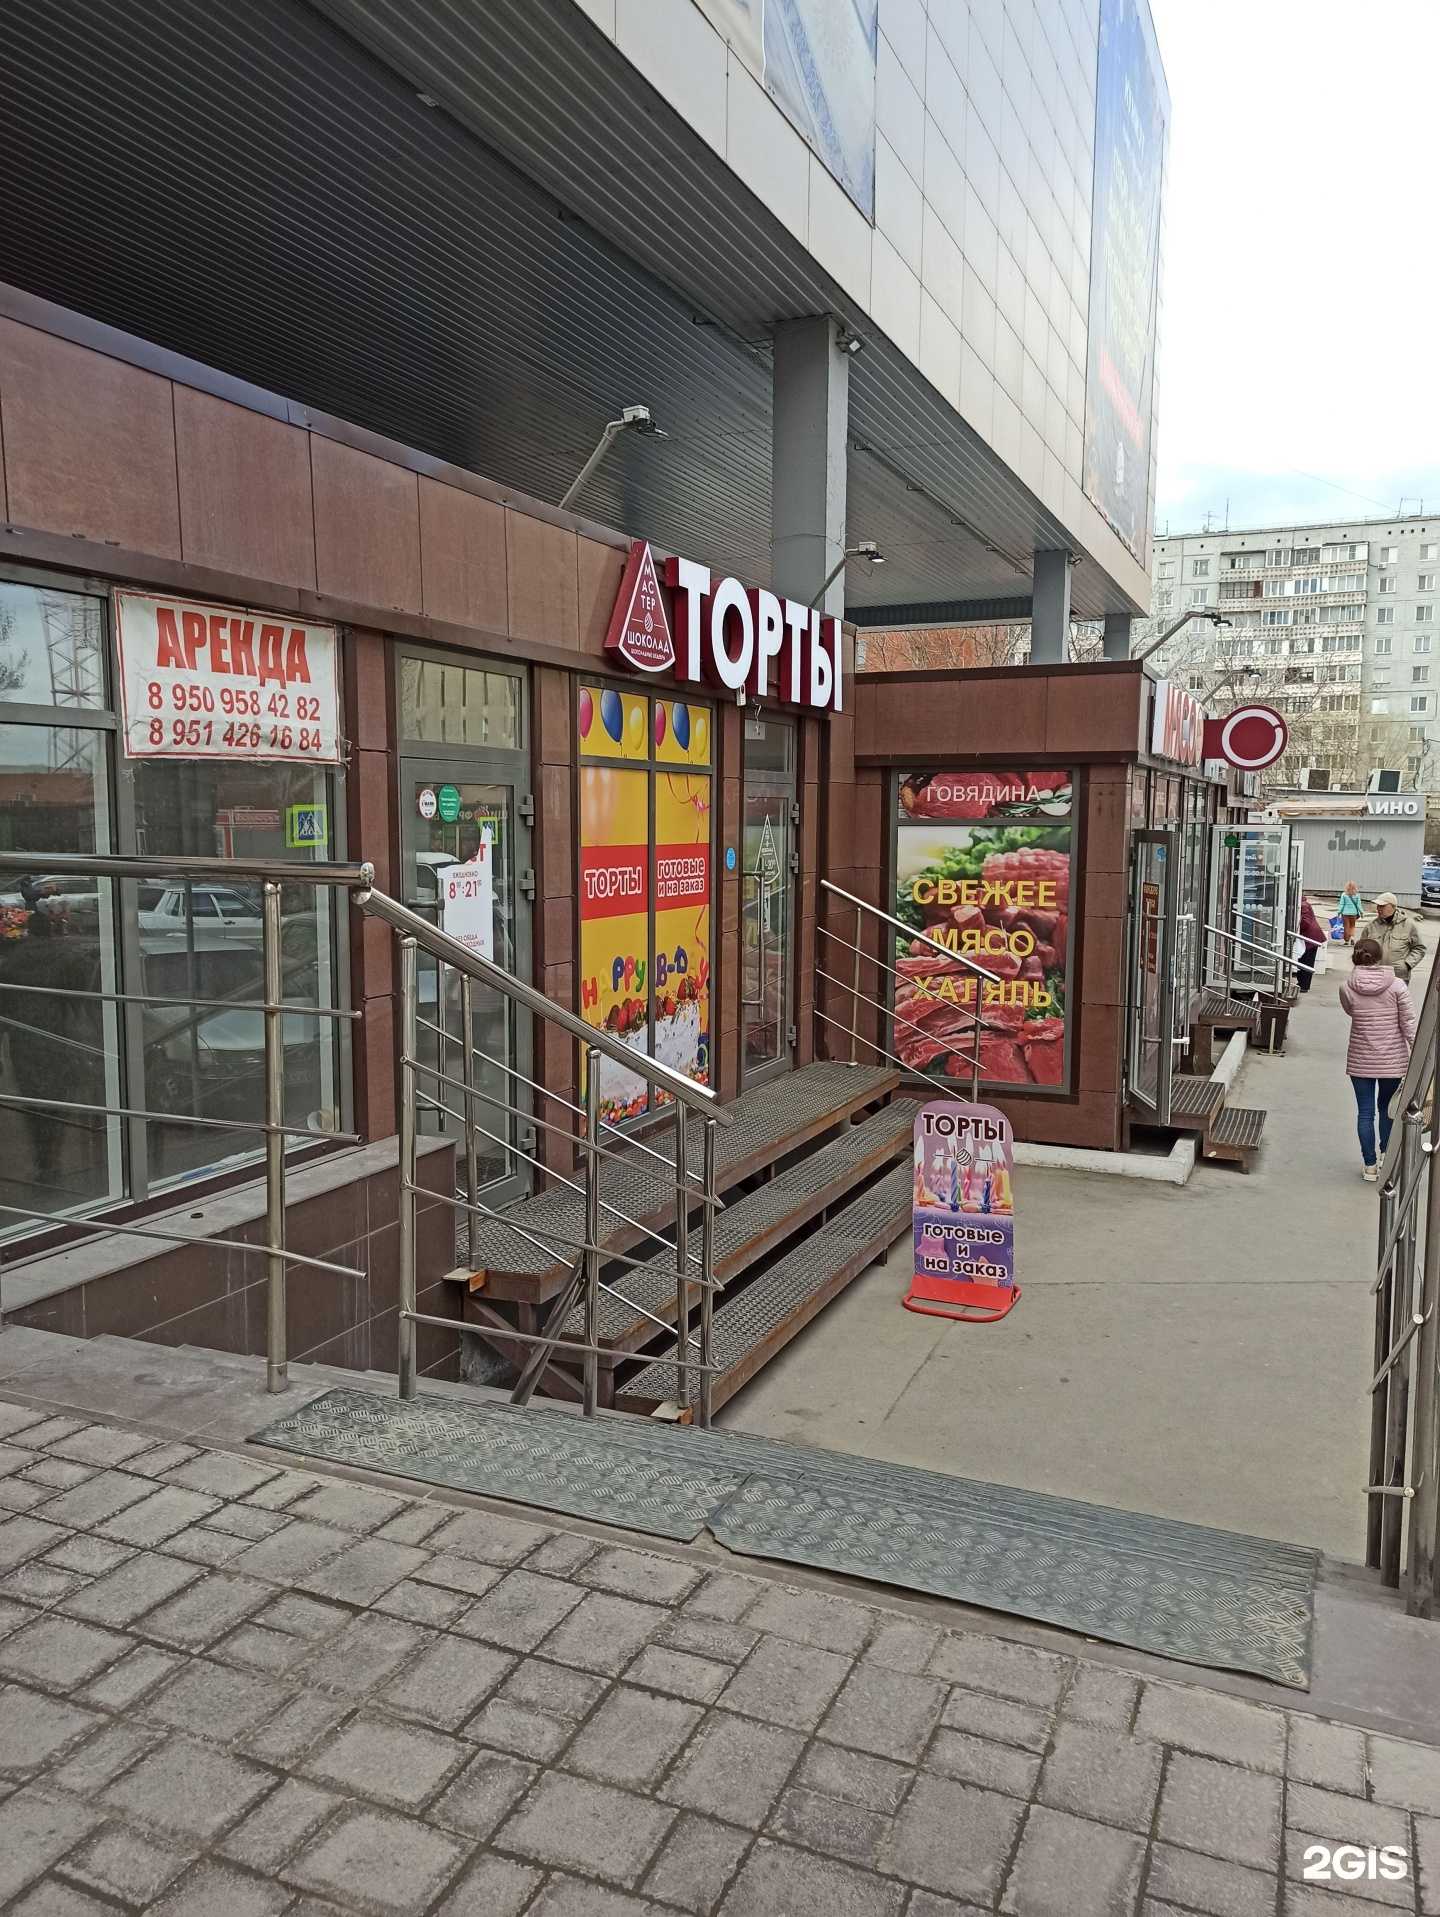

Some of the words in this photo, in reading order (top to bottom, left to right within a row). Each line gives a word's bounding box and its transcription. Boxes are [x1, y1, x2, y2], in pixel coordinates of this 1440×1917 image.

[641, 580, 655, 594] АС
[641, 595, 656, 611] ТЕР
[627, 631, 670, 654] ШОКОЛАД
[678, 556, 843, 712] ТОРТЫ
[156, 607, 311, 689] АРЕНДА
[147, 682, 163, 710] 8
[172, 683, 215, 713] 950
[220, 688, 261, 716] 958
[268, 693, 290, 719] 42
[296, 696, 321, 721] 82
[149, 718, 163, 745] 8
[172, 719, 213, 746] 951
[222, 722, 261, 748] 426
[270, 725, 293, 750] 16
[299, 728, 322, 752] 84
[926, 785, 1041, 805] ГОВЯДИНА
[657, 857, 705, 879] готовые
[584, 866, 642, 899] ТОРТЫ
[657, 881, 665, 897] и
[666, 880, 679, 896] на
[680, 879, 705, 894] заказ
[912, 879, 1057, 907] СВЕЖЕЕ
[932, 928, 1034, 957] МЯСО
[922, 1112, 1005, 1142] ТОРТЫ
[923, 1223, 1004, 1244] готовые
[957, 1243, 969, 1258] и
[924, 1257, 949, 1272] на
[953, 1260, 1007, 1279] заказ
